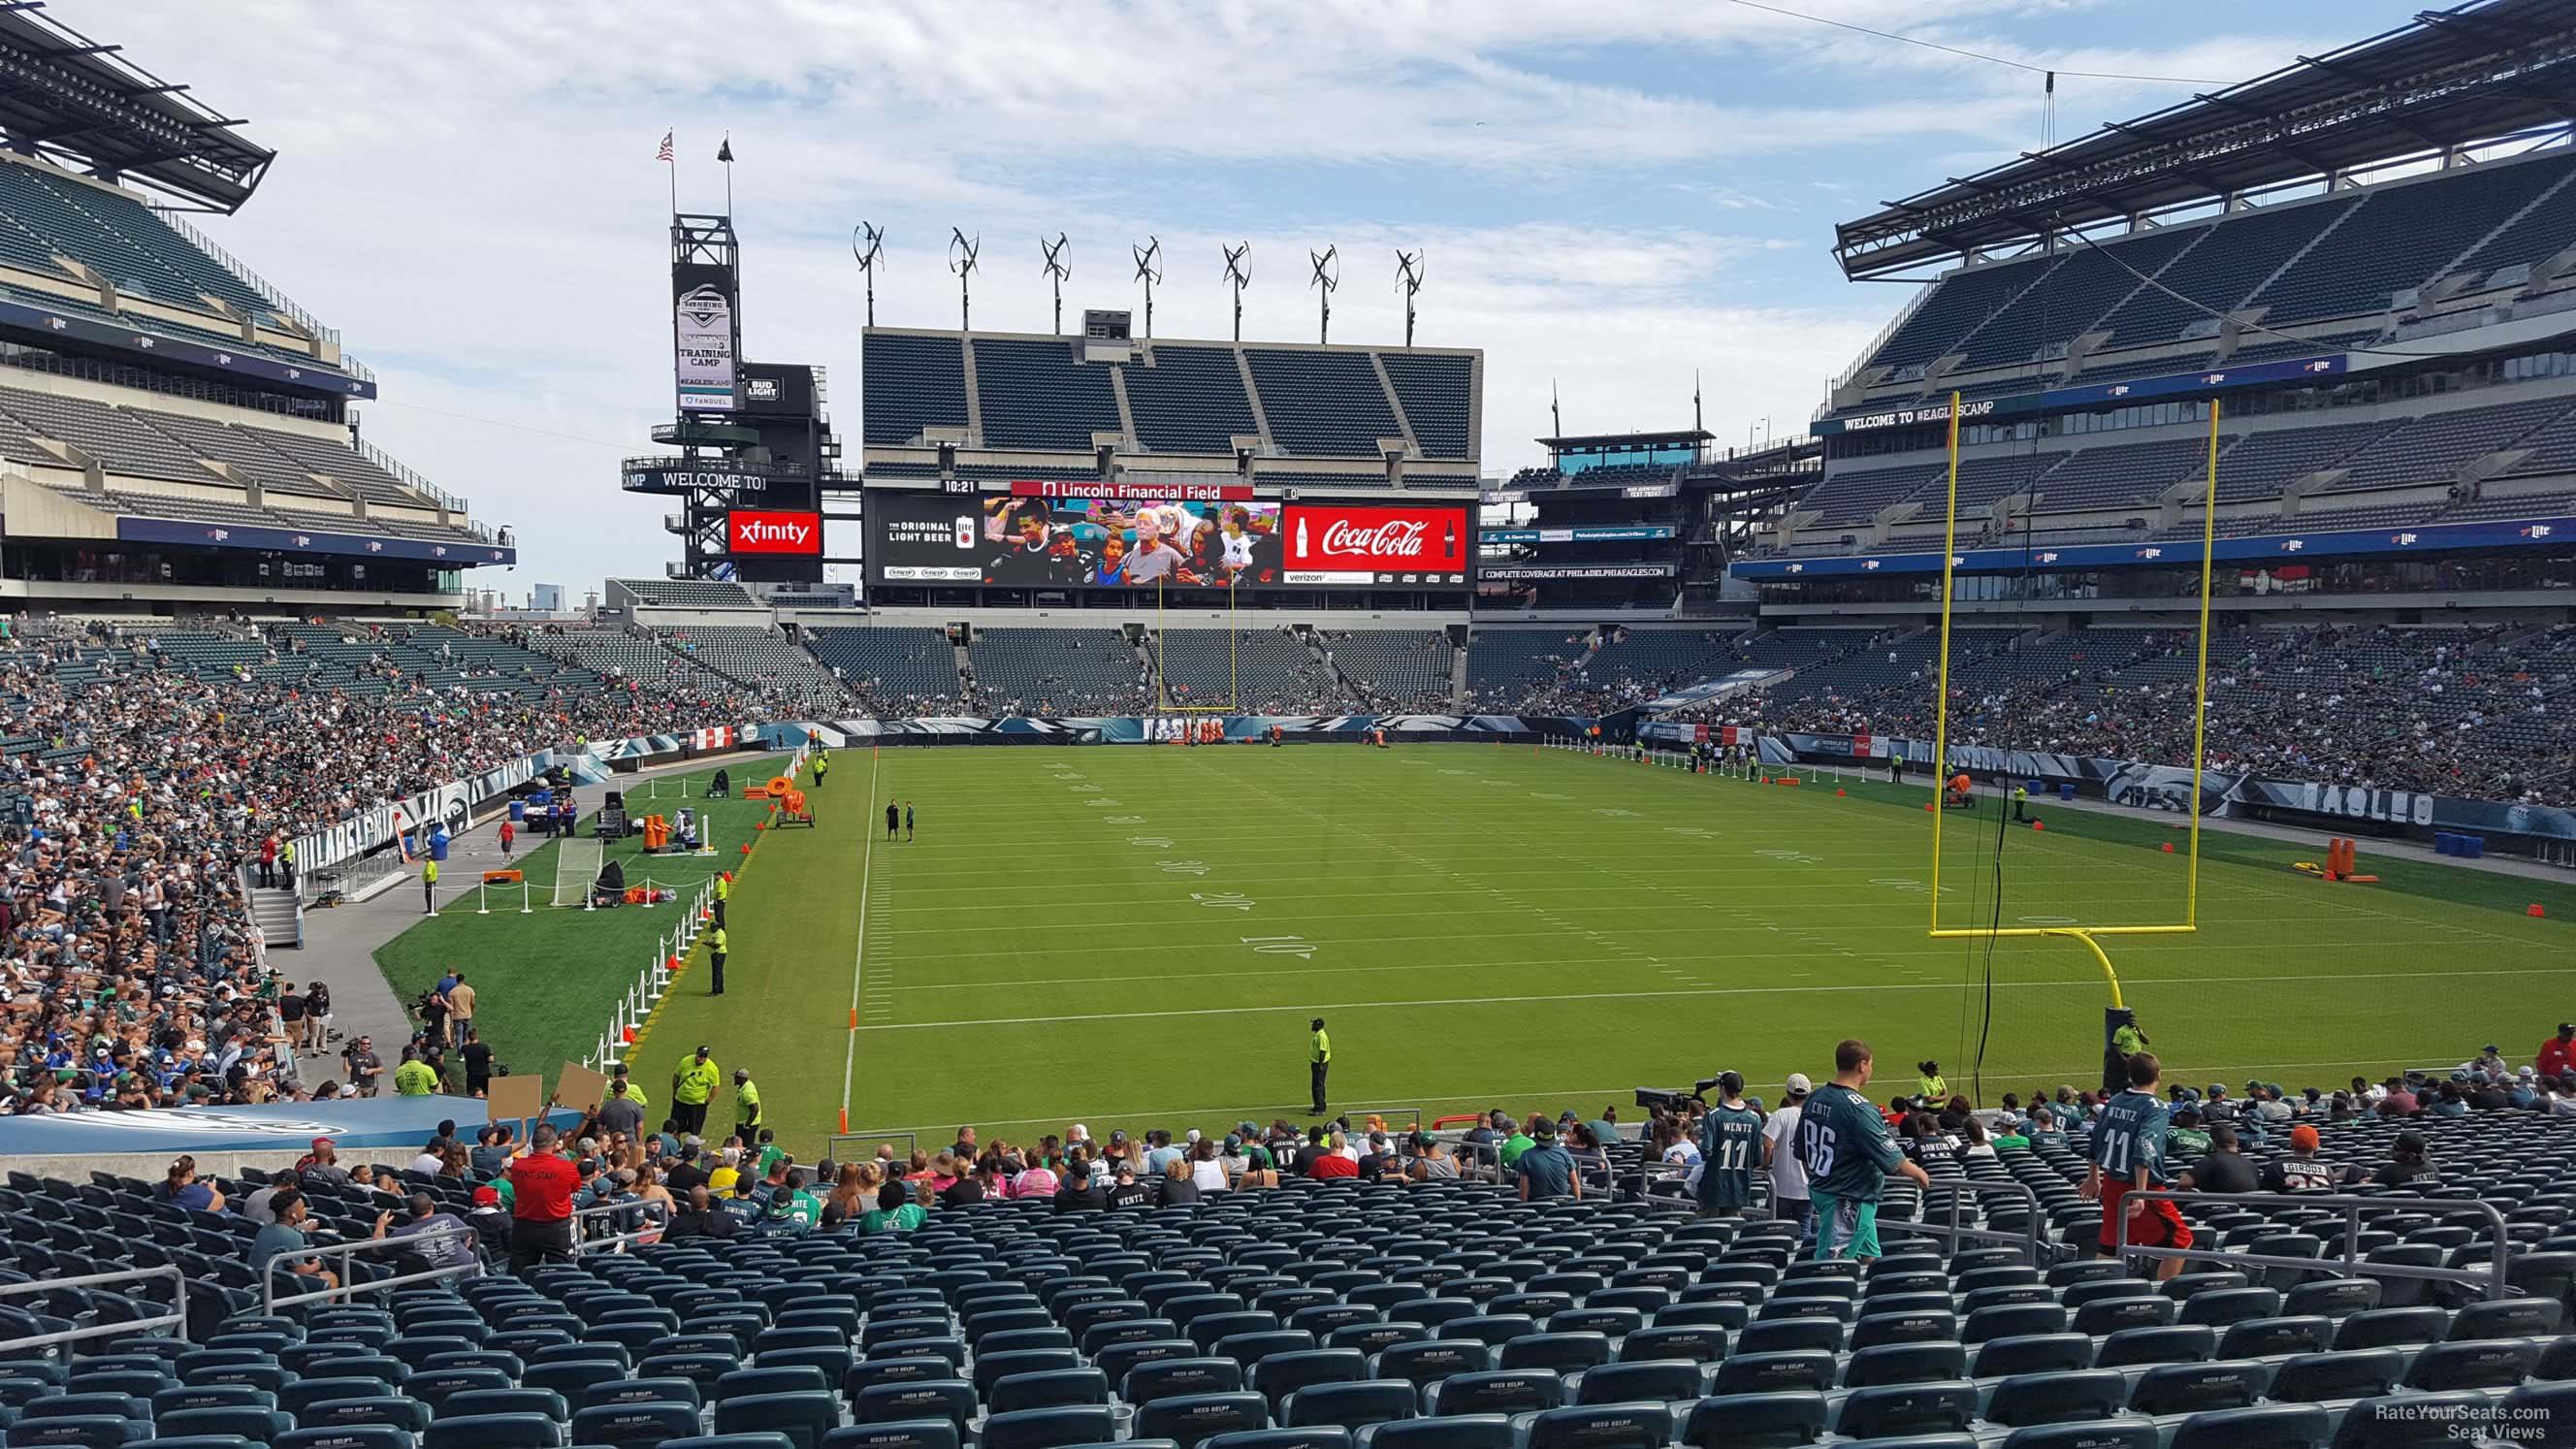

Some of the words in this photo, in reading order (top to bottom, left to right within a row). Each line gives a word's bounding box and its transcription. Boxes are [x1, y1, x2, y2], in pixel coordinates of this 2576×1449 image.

[679, 349, 730, 359] TRAINING
[691, 358, 721, 367] CAMP
[2314, 360, 2331, 372] Lite
[2209, 373, 2225, 385] Lite
[1845, 413, 1895, 431] WELCOME
[1898, 411, 1914, 424] TO
[622, 473, 646, 487] CAMP
[662, 472, 741, 488] WELCOME
[744, 475, 761, 491] TO
[946, 481, 974, 493] 10:21
[1062, 484, 1114, 498] Lincoln
[1118, 485, 1182, 499] Financial
[1187, 486, 1221, 500] Field
[739, 520, 810, 544] xfinity
[901, 522, 951, 531] ORIGINAL
[2531, 525, 2551, 539] Lite
[888, 532, 920, 542] LIGHT
[924, 532, 951, 542] BEER
[1322, 519, 1430, 556] Coca-Cola
[2400, 532, 2417, 545] Lite
[2288, 539, 2303, 551] Lite
[2044, 551, 2058, 563] Lite
[2145, 548, 2162, 560] Lite
[1289, 572, 1322, 582] verizon
[1486, 570, 1520, 579] COMPLETE
[1521, 569, 1556, 578] COVERAGE
[1566, 568, 1664, 577] PHILADELPHIAEAGLES.COM
[1240, 935, 1318, 953] 10
[2108, 1107, 2138, 1122] WENTZ
[1723, 1121, 1753, 1133] WENTZ
[1804, 1118, 1837, 1177] 86
[2101, 1128, 2130, 1175] 11
[1720, 1139, 1749, 1171] 11
[2287, 1164, 2323, 1175] GIROUX
[790, 1199, 808, 1208] HITE
[1117, 1193, 1144, 1207] WENTZ
